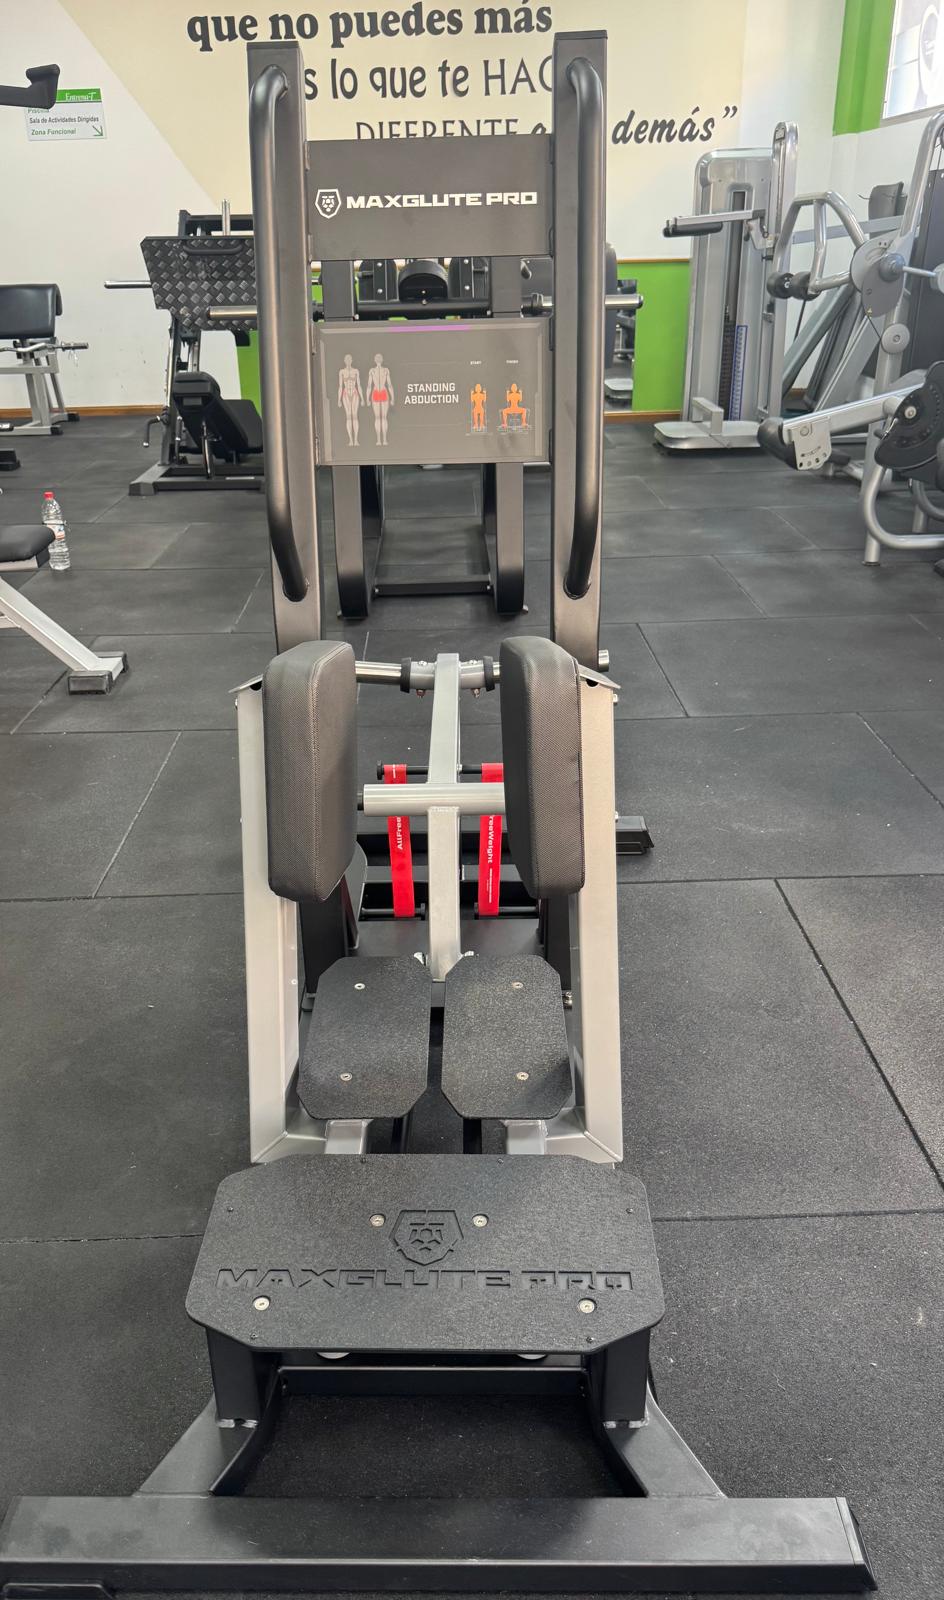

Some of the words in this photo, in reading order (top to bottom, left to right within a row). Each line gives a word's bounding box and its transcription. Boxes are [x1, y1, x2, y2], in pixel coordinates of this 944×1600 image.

[186, 14, 259, 52] que
[269, 13, 319, 40] no
[329, 1, 464, 49] puedes
[474, 0, 553, 34] más
[331, 58, 358, 100] lo
[369, 65, 427, 99] que
[438, 59, 469, 98] te
[77, 116, 99, 124] Dirigidas
[346, 193, 483, 209] MAXGLUTE
[486, 191, 538, 206] PRO
[407, 382, 456, 393] STANDING
[404, 394, 459, 404] ABDUCTION
[215, 1268, 511, 1290] MAXGLUTE
[521, 1270, 633, 1291] PRO
